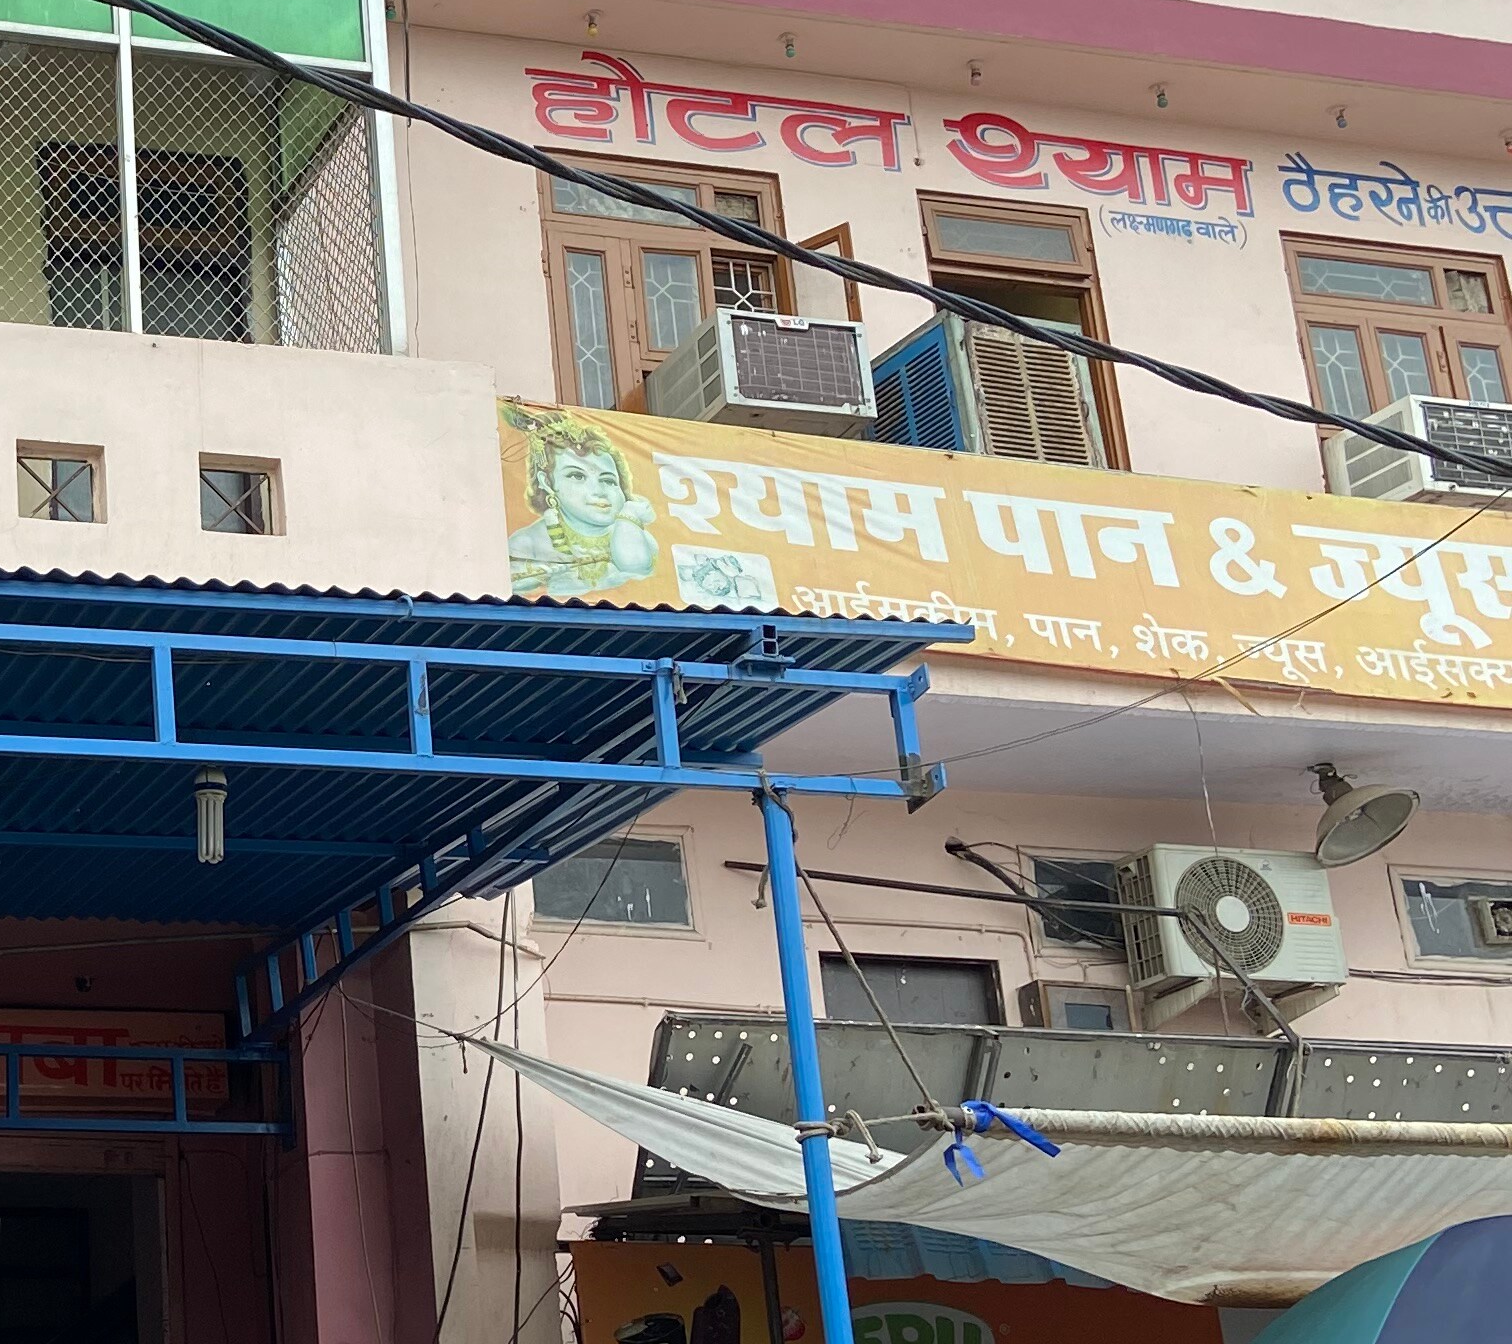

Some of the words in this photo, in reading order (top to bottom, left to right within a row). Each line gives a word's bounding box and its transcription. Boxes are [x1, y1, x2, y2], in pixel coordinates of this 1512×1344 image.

[524, 50, 912, 172] होटल
[944, 111, 1255, 217] श्याम
[652, 452, 947, 564] श्याम
[964, 489, 1180, 588] पान
[1208, 516, 1288, 599] &
[1290, 914, 1329, 924] HITACHI
